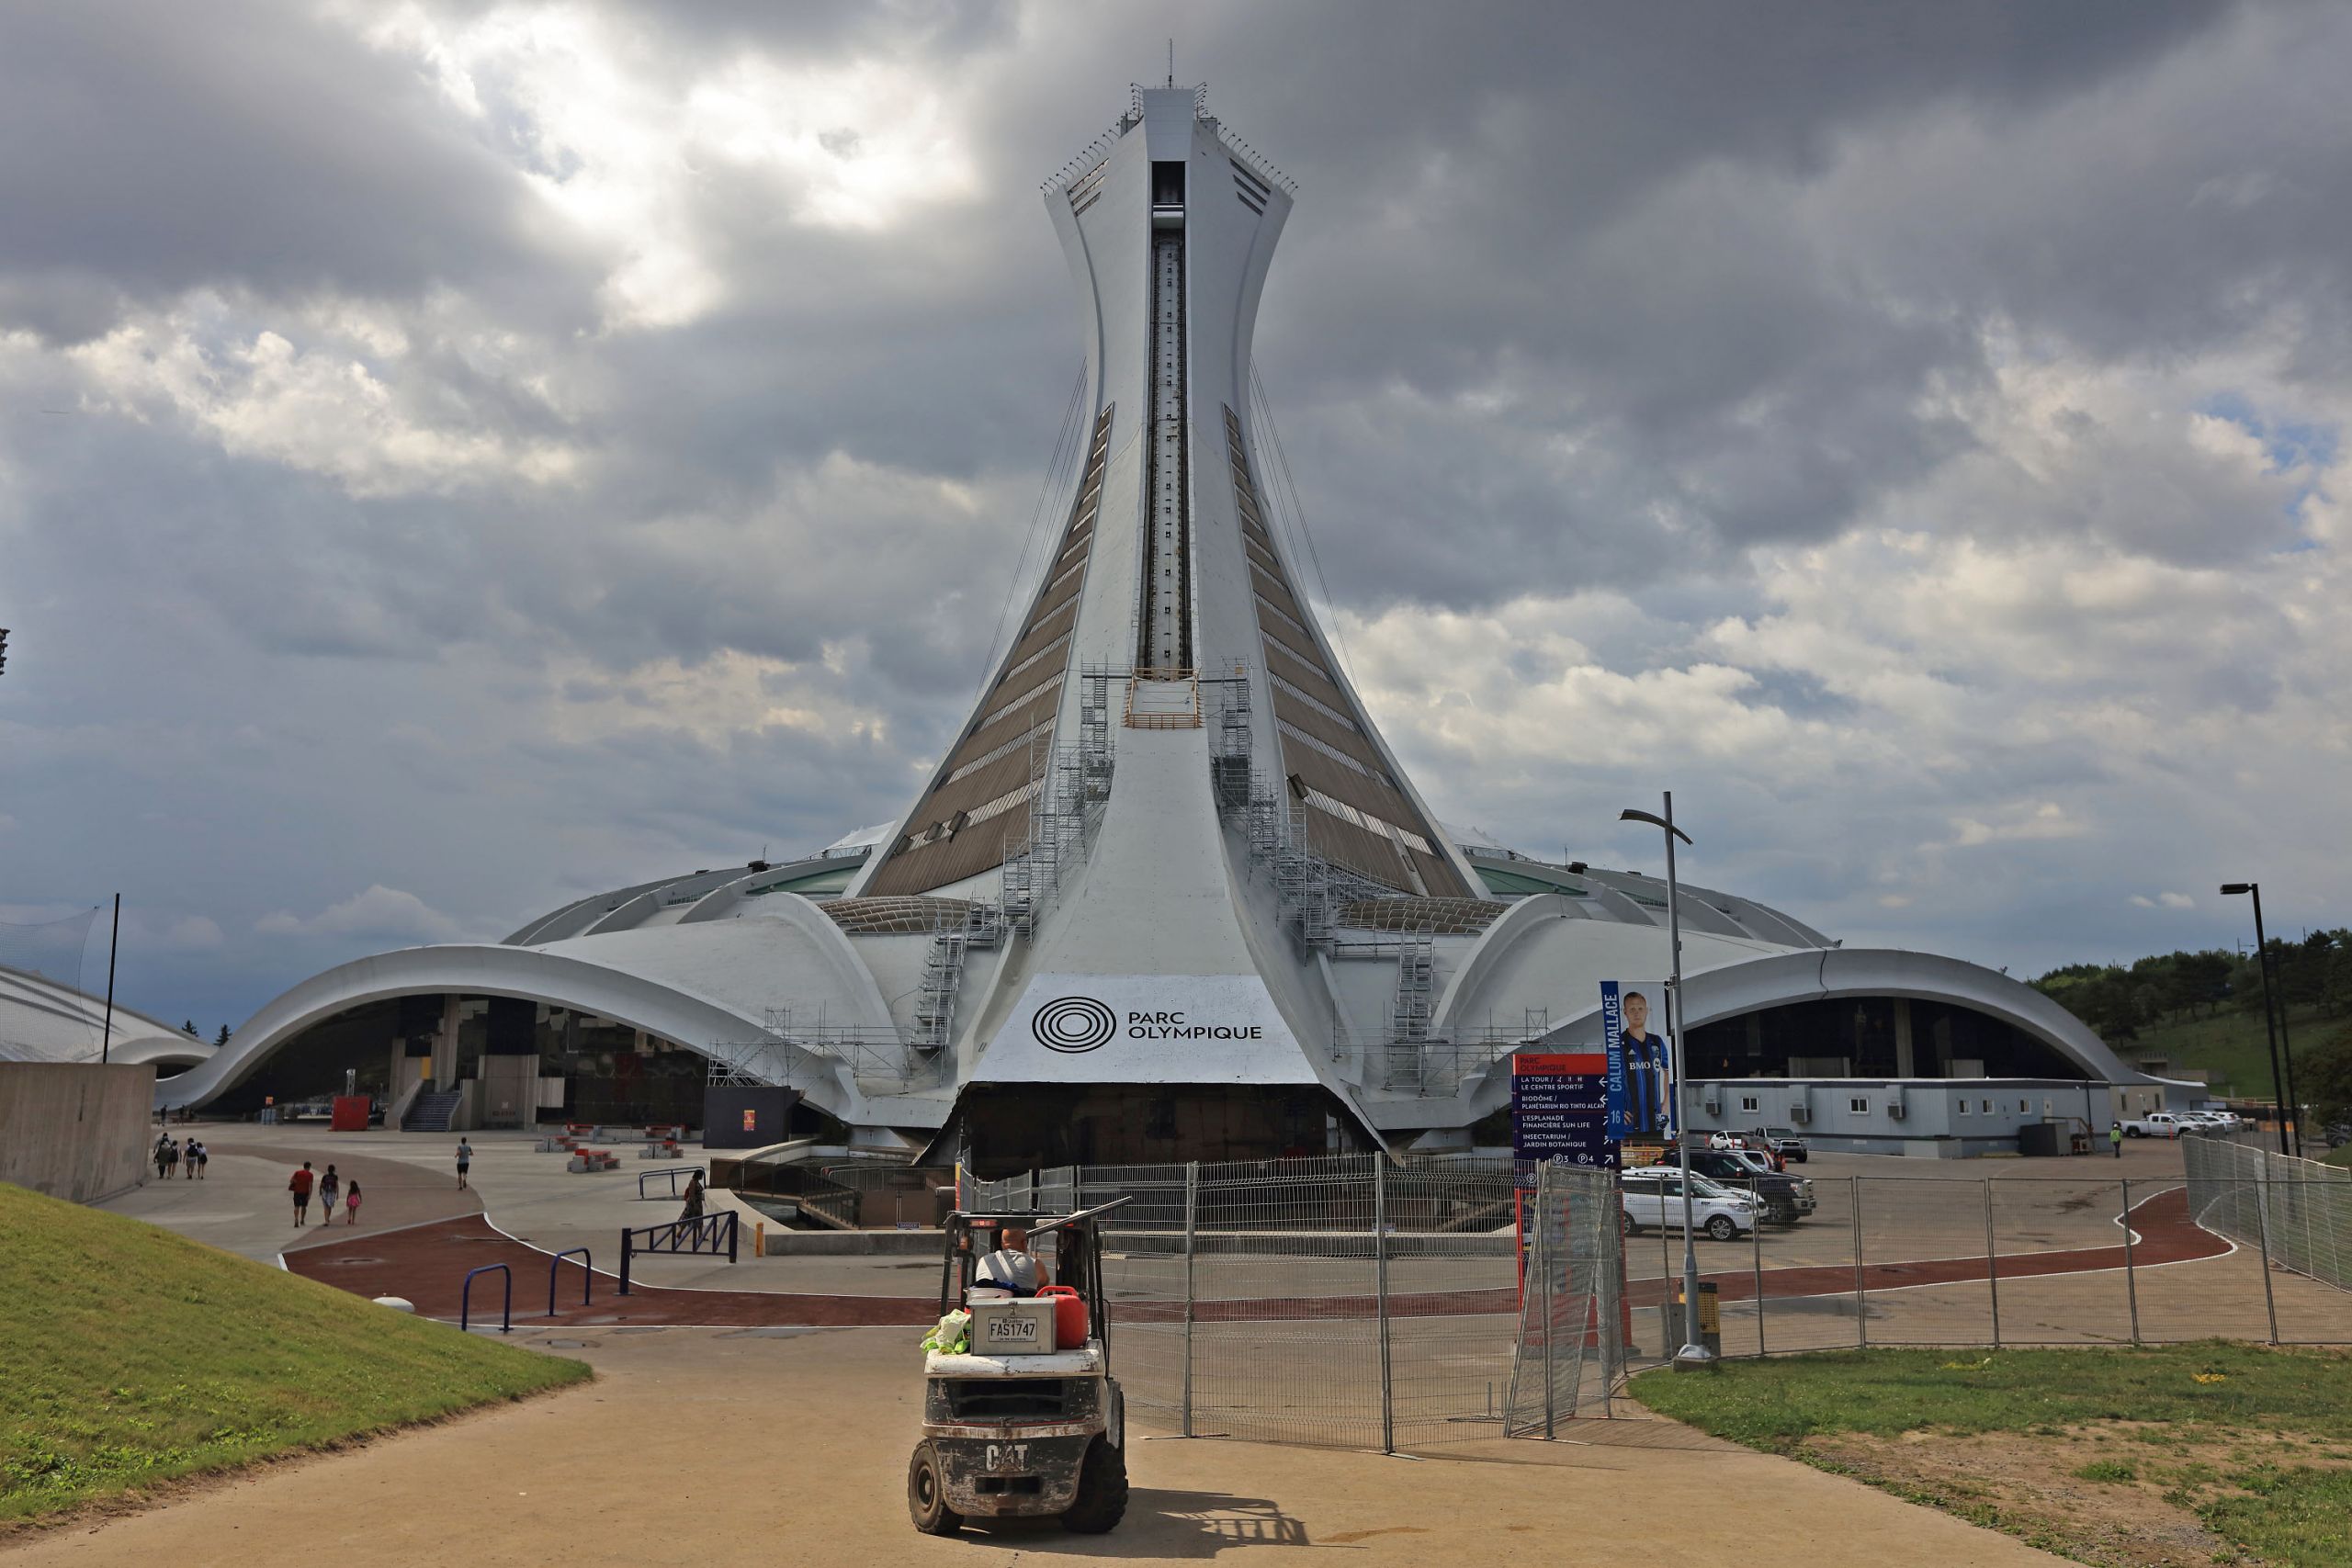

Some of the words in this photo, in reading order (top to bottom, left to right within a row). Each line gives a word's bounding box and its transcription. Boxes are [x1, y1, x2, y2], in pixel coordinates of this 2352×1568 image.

[1128, 1011, 1185, 1024] PARC
[1604, 994, 1621, 1048] MALLACE
[1128, 1026, 1262, 1040] OLYMPIQUE
[1610, 1051, 1623, 1092] CALUM
[1628, 1061, 1651, 1070] BMO
[1611, 1110, 1621, 1124] 16
[990, 1323, 1035, 1337] FAS1747
[986, 1444, 1028, 1472] CAT
